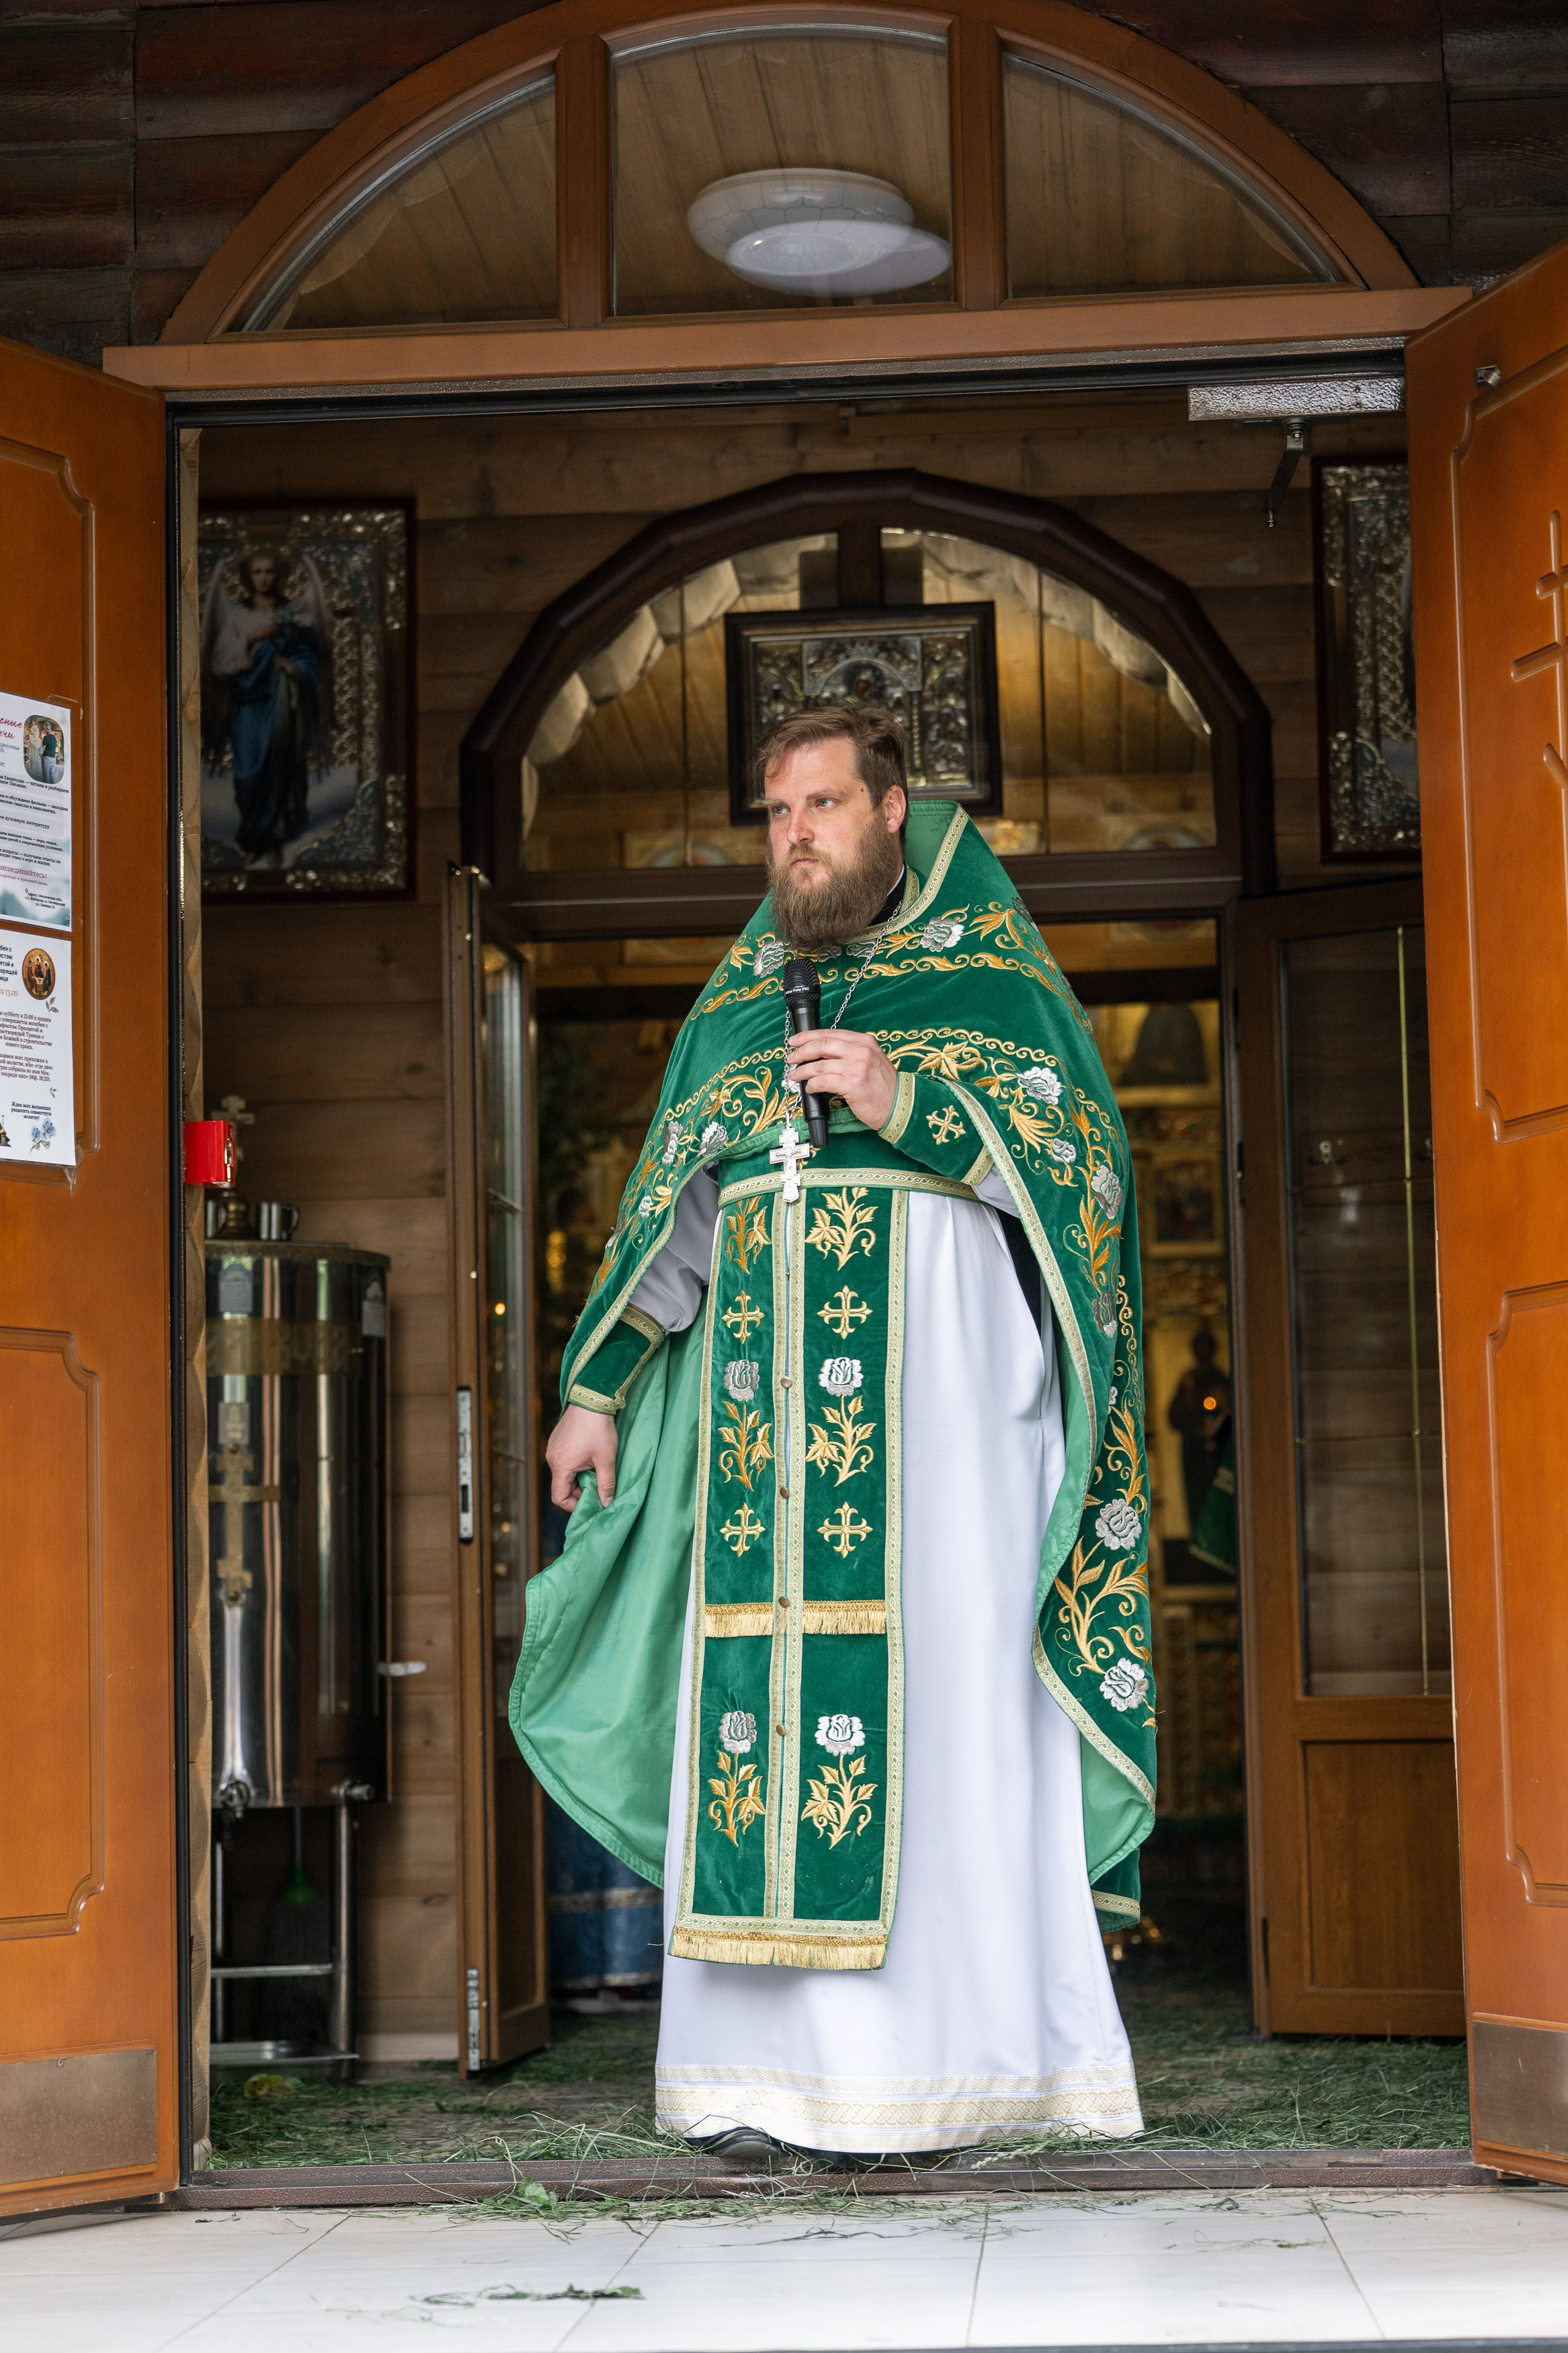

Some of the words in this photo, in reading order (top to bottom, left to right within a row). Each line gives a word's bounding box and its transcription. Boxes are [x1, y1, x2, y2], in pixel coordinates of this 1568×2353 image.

[0, 865, 48, 879] исоединяйтесь!
[3, 1011, 19, 1019] субботу
[2, 1017, 28, 1025] совершается
[17, 1025, 39, 1033] Пресвятой
[26, 1031, 41, 1039] Троице
[23, 1039, 52, 1047] строительстве
